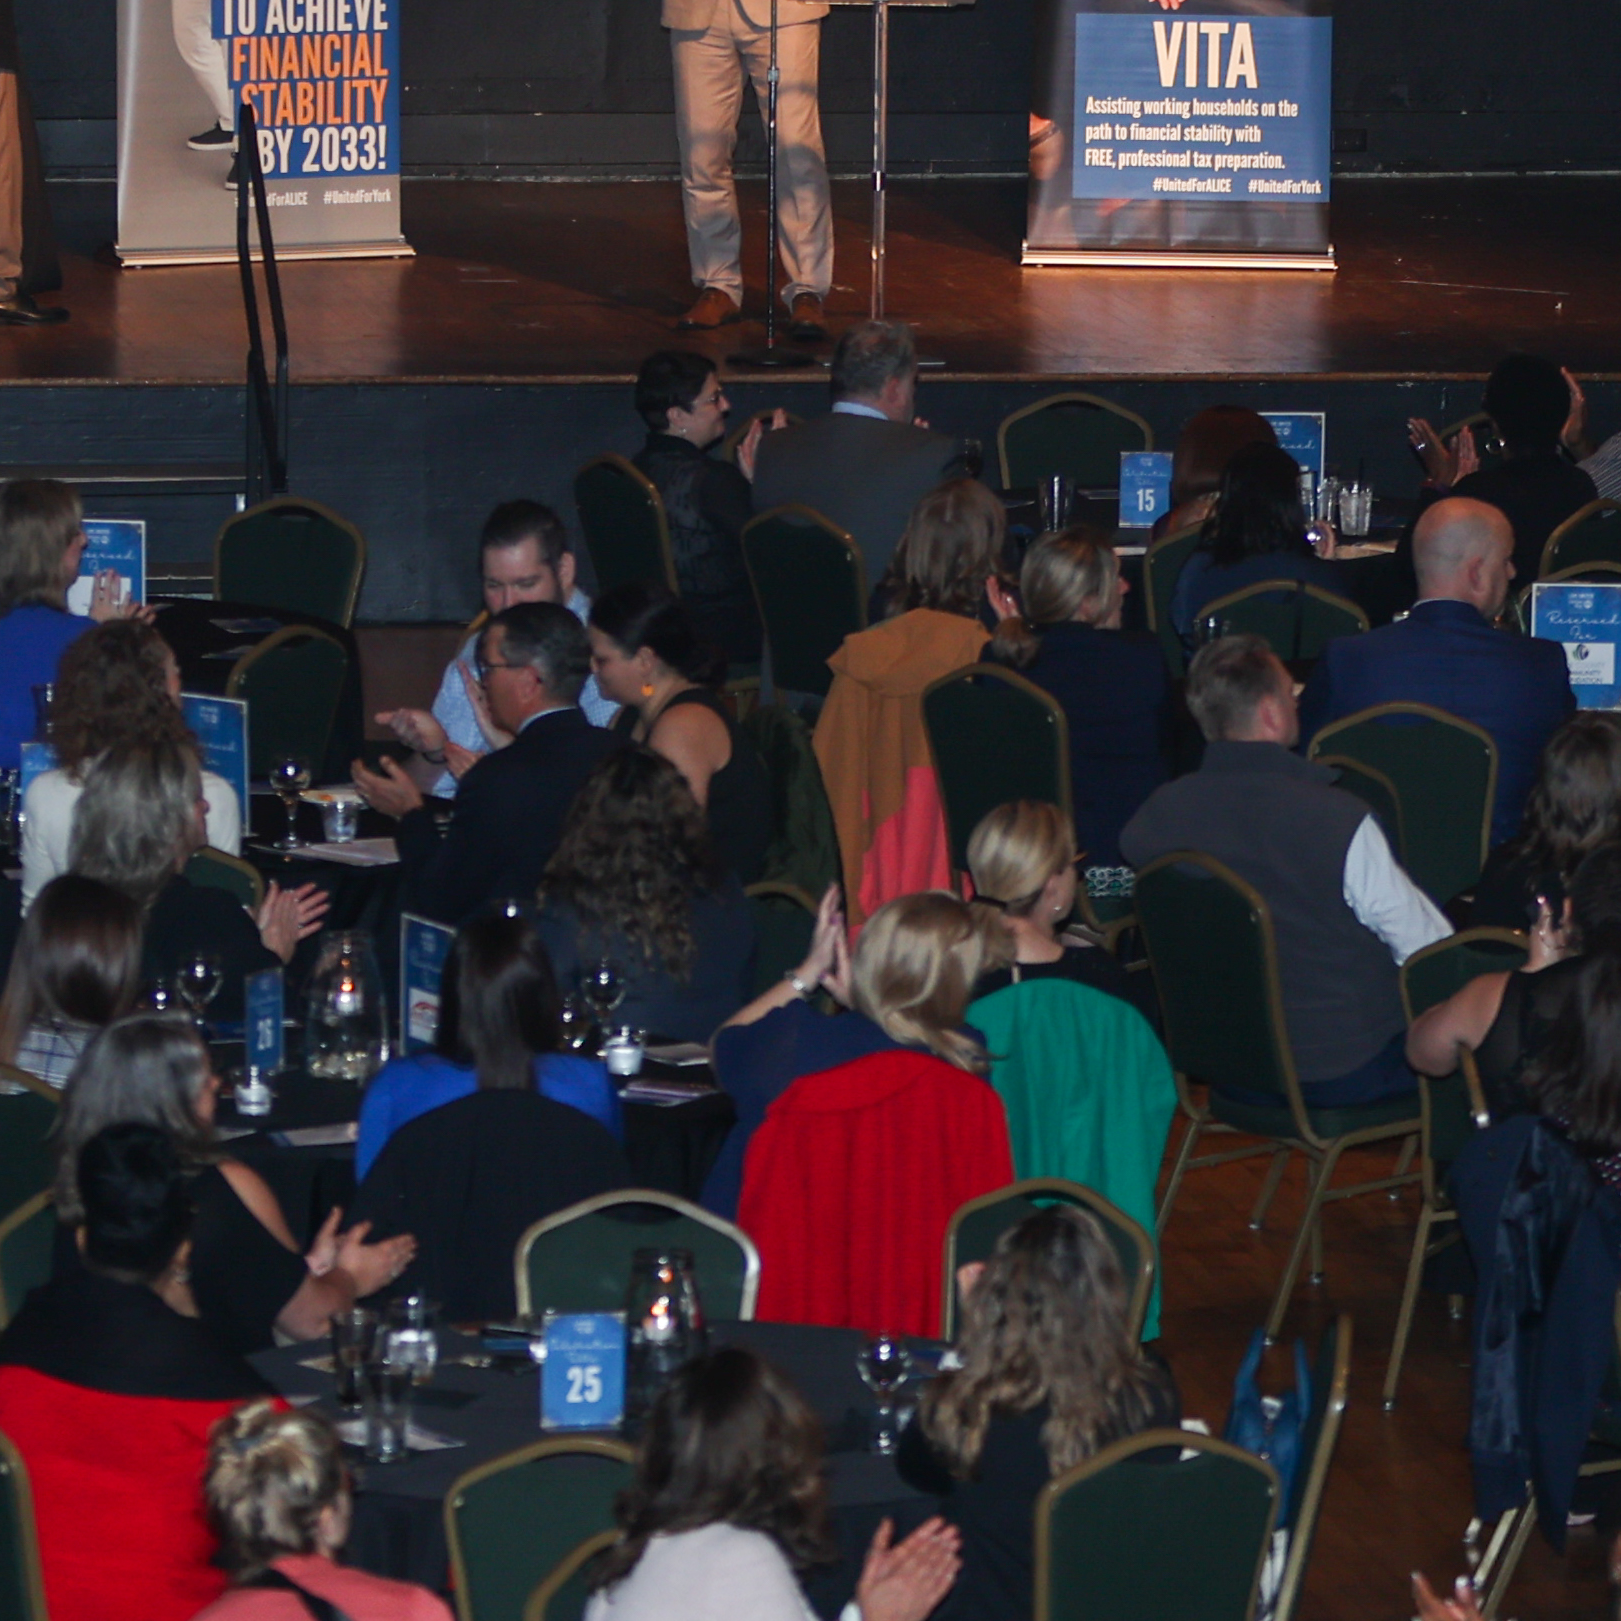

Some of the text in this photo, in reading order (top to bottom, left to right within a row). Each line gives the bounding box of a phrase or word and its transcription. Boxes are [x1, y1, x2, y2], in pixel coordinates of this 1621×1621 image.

[232, 32, 390, 82] FINANCIAL
[1153, 21, 1258, 89] VITA
[1086, 96, 1299, 119] Assisting working households on the
[1086, 123, 1261, 146] path to financial stability with
[258, 124, 387, 174] BY 2033!
[1085, 149, 1285, 172] FREE, professional tax preparation.
[323, 188, 391, 205] #UnitedForYork
[1153, 177, 1322, 194] #UnitedForALICE #UnitedForYork
[1136, 488, 1155, 512] 15
[1546, 610, 1621, 625] Reserved
[566, 1364, 603, 1403] 25
